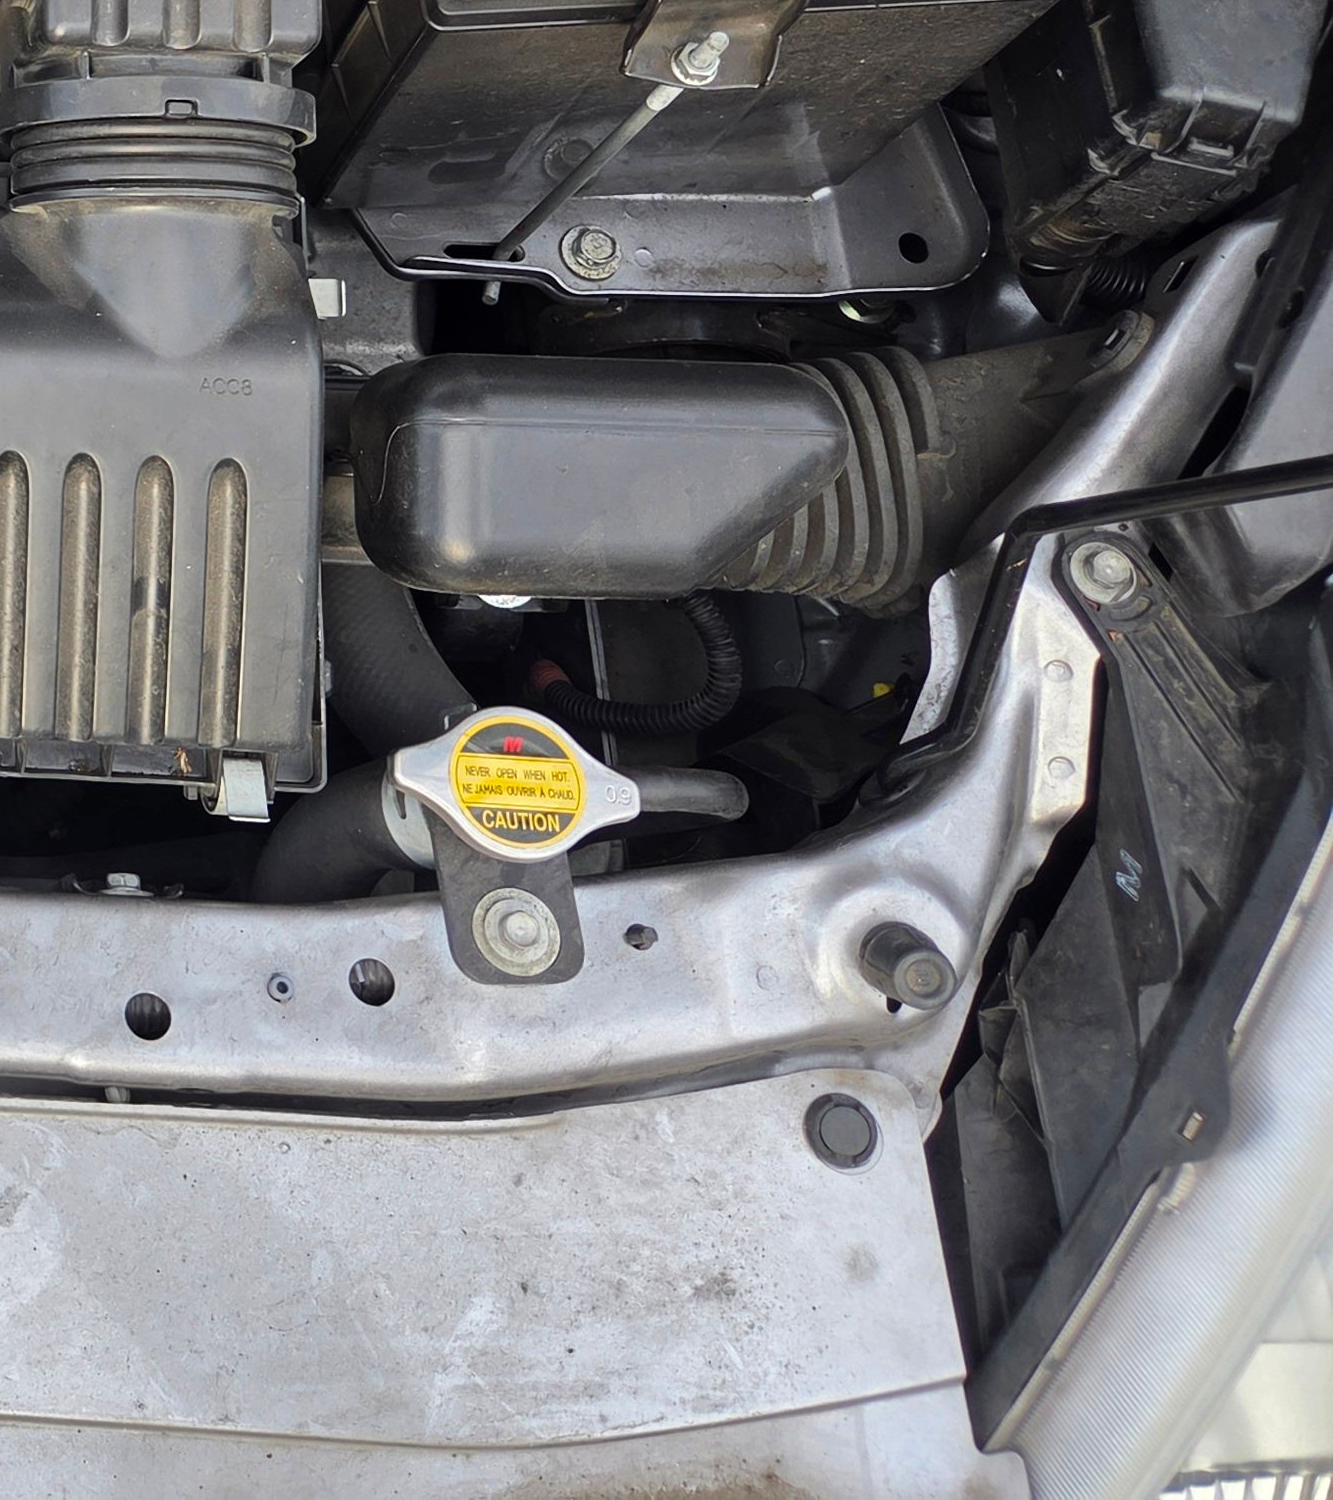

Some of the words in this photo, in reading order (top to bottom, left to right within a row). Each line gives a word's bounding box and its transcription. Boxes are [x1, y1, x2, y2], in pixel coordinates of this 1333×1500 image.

[465, 765, 491, 778] NEVER
[496, 767, 518, 779] OPEN
[523, 769, 546, 781] WHEN
[462, 783, 474, 795] NE
[474, 784, 503, 796] JAMAIS
[506, 785, 536, 798] OUVRIR
[605, 784, 632, 805] 0.9
[482, 810, 561, 833] CAUTION
